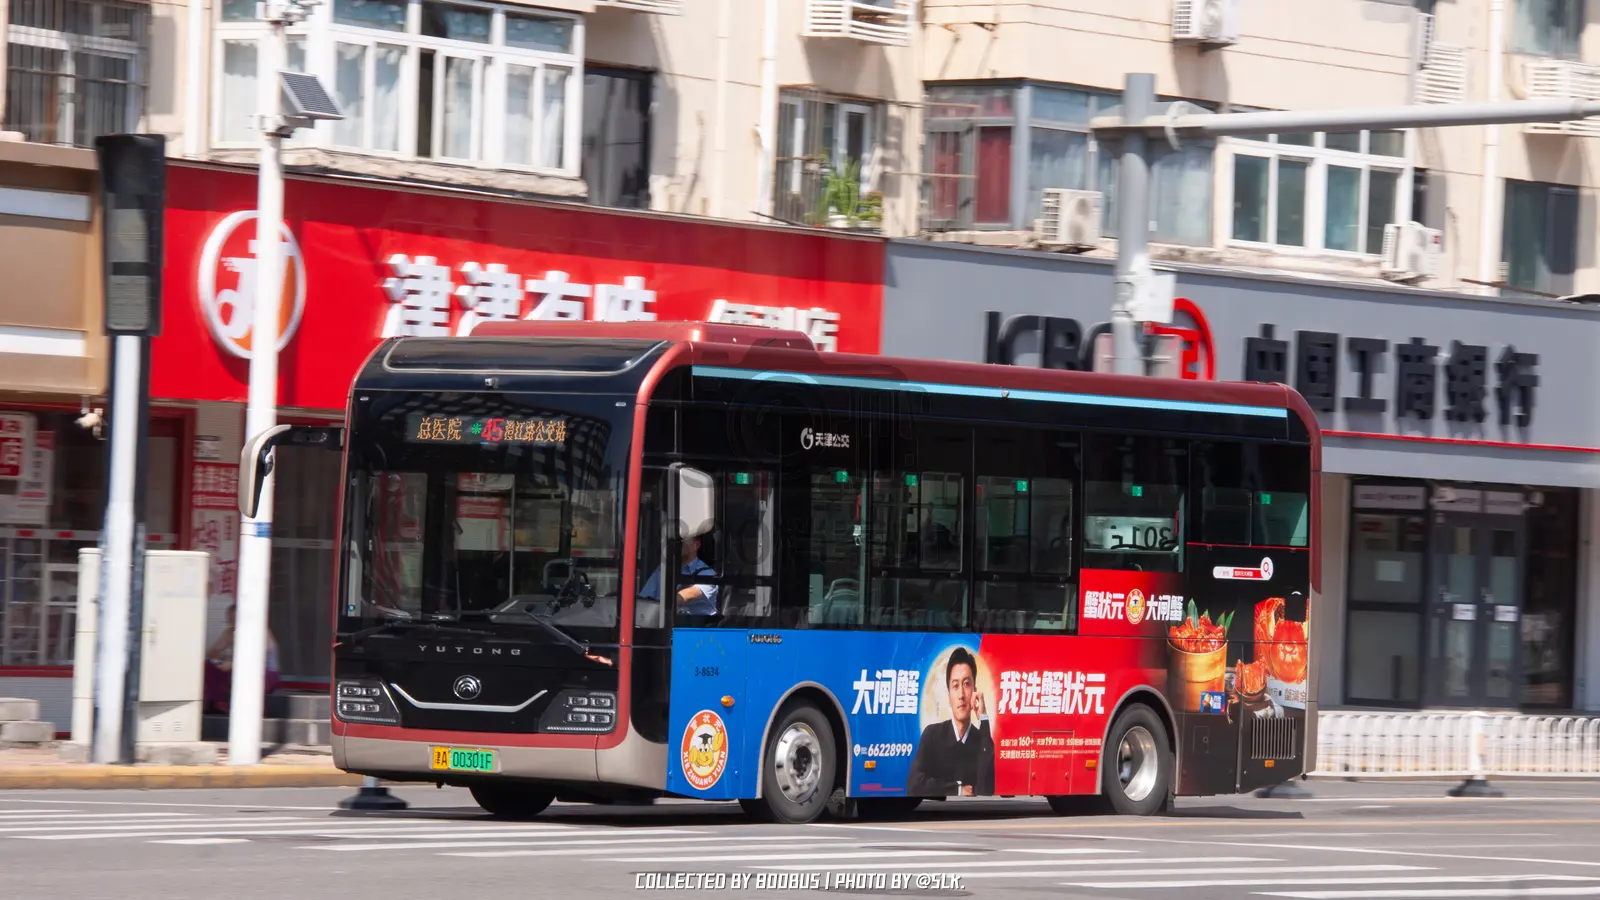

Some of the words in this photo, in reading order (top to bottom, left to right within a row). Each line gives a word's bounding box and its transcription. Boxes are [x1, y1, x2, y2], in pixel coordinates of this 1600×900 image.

[1243, 323, 1540, 427] 中国工商银行
[417, 417, 463, 440] 总医院
[481, 418, 505, 441] 45
[815, 432, 850, 448] 天津公交
[1083, 590, 1125, 620] 蟹状元
[1145, 594, 1184, 621] 大闸蟹
[419, 645, 521, 656] YUTONG
[851, 669, 920, 715] 大闸蟹
[998, 670, 1106, 715] 我选蟹状元
[867, 743, 913, 757] 66228999
